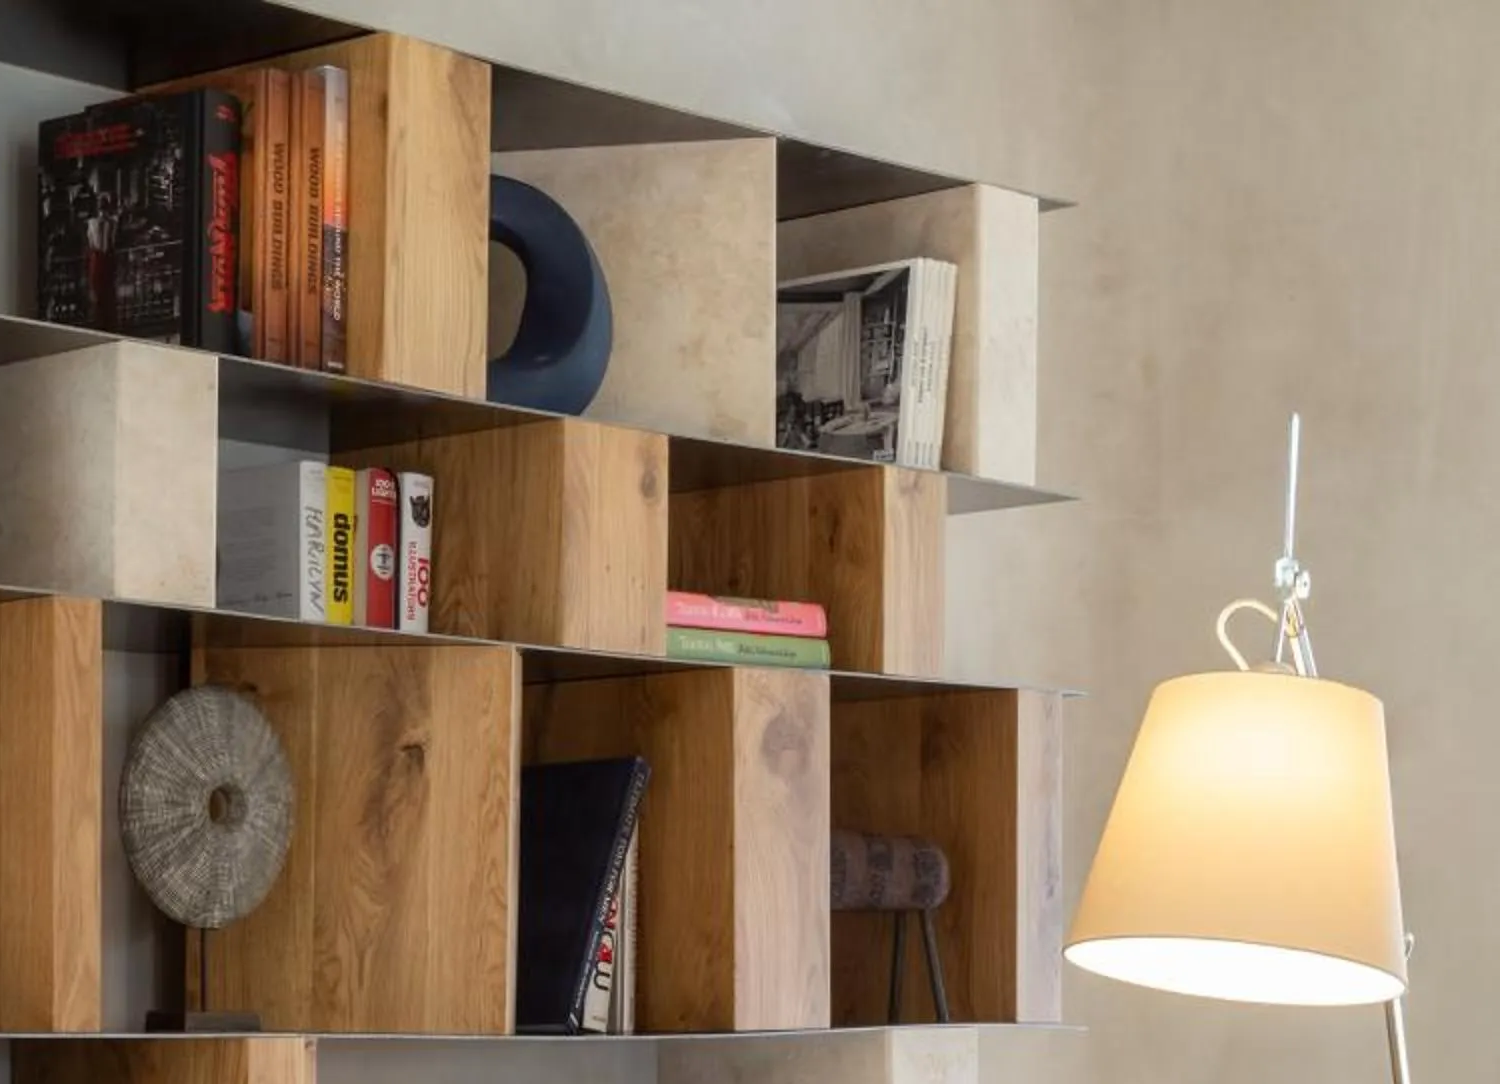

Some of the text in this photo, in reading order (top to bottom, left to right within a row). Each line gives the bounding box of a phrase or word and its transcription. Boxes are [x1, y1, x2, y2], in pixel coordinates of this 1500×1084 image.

[270, 142, 286, 291] WOOD BUILDINGS
[307, 147, 322, 294] WOOD BUILDINGS
[332, 512, 352, 604] domus
[417, 557, 430, 607] 100
